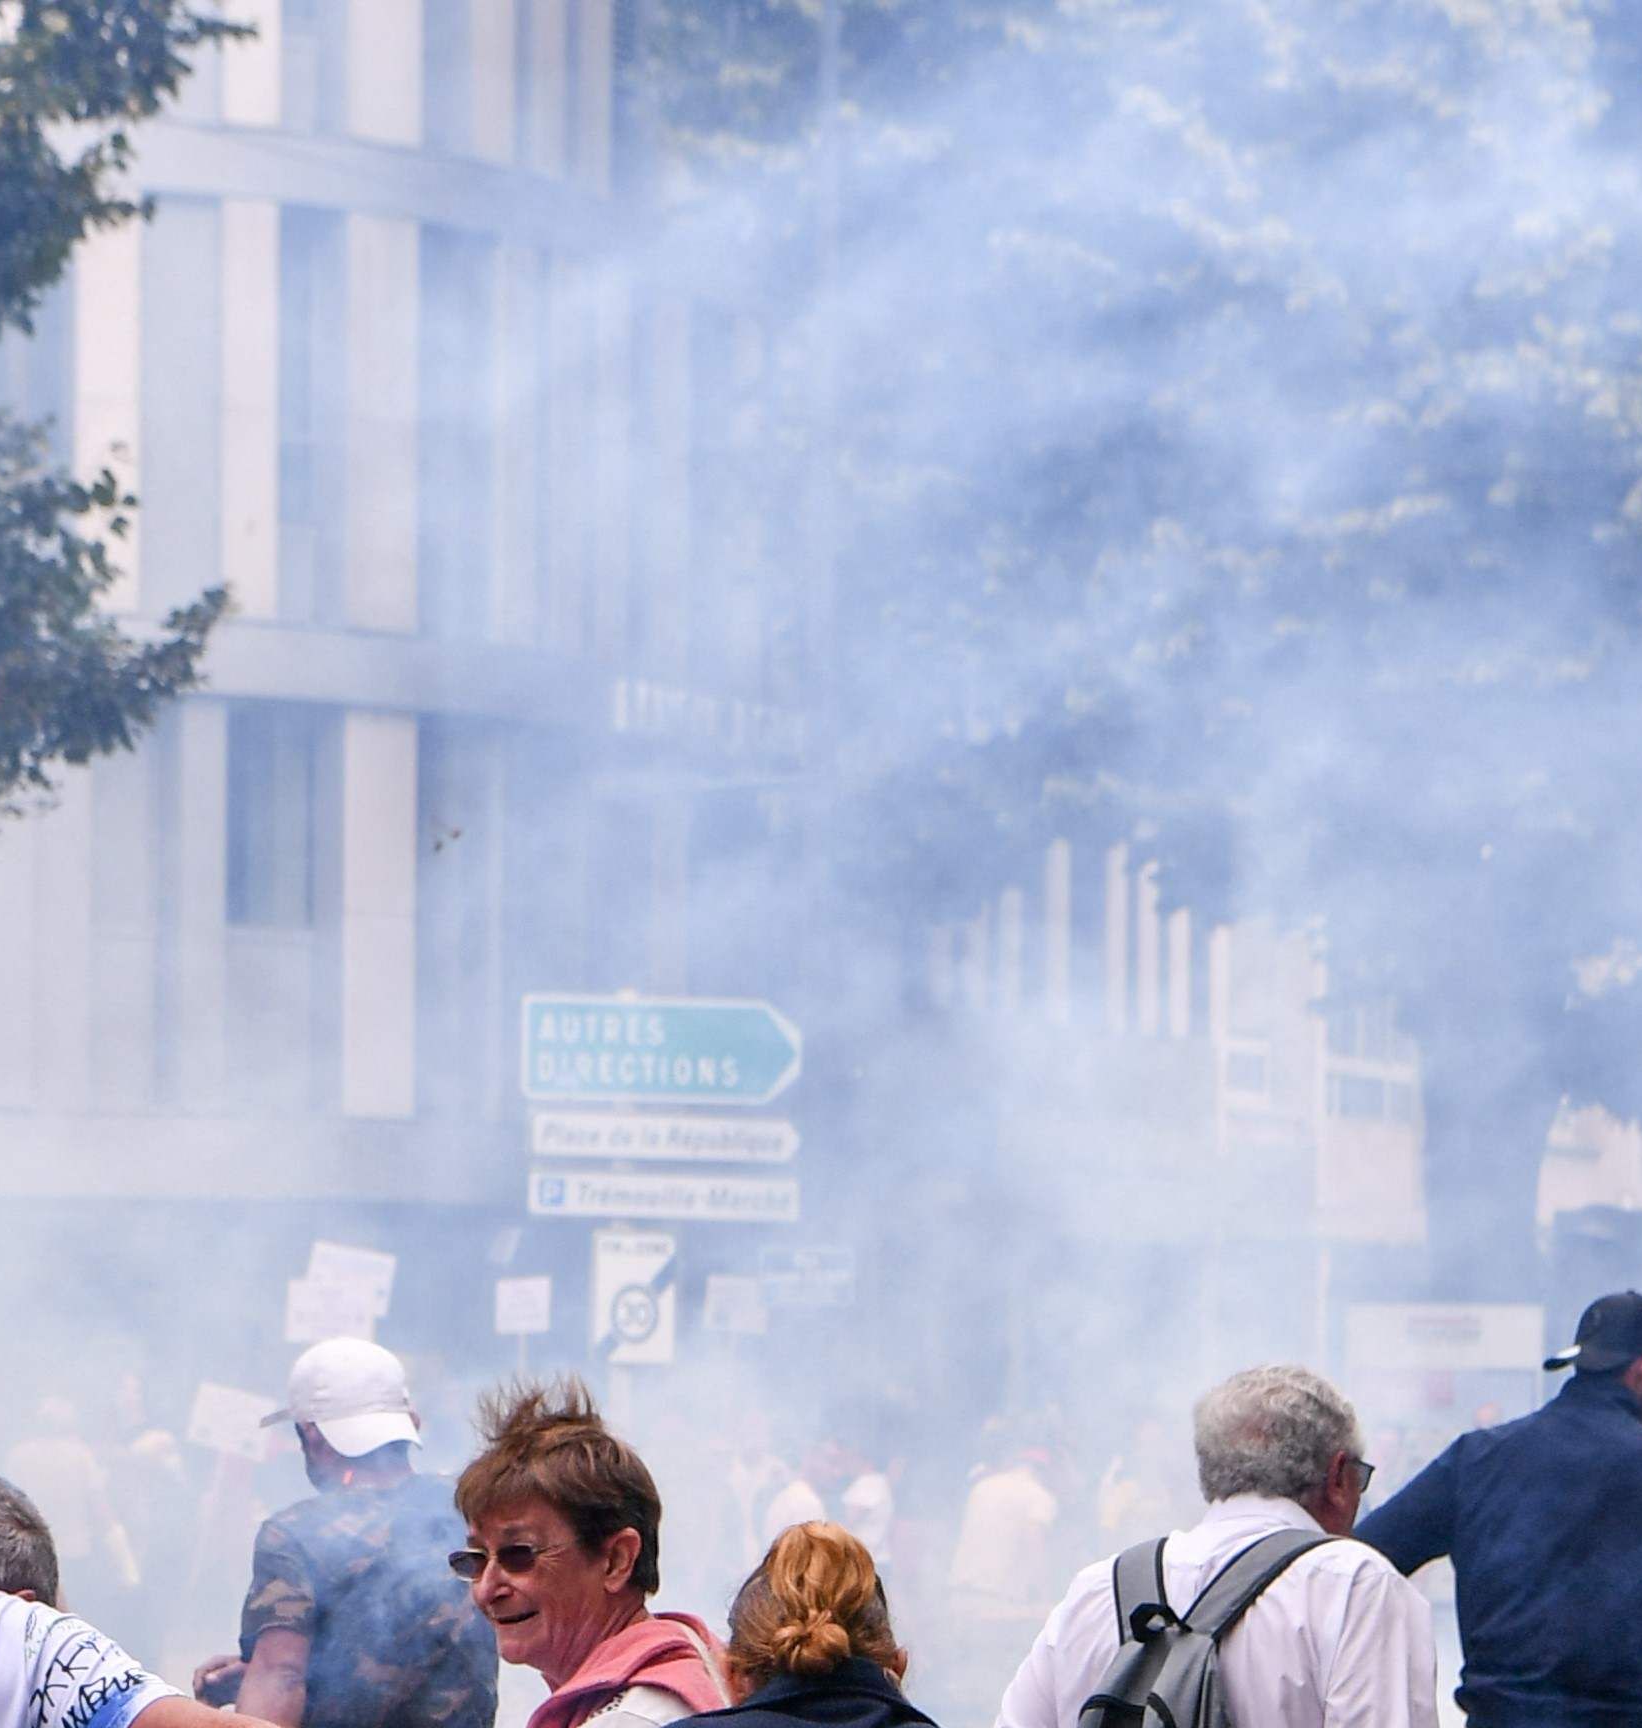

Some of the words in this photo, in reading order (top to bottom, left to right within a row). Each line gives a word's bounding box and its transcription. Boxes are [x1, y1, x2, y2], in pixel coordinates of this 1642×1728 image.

[536, 1010, 666, 1045] AUTRES
[536, 1049, 741, 1088] DIRECTIONS
[542, 1122, 601, 1147] Place
[608, 1124, 633, 1147] de
[666, 1125, 785, 1154] République
[621, 1300, 649, 1325] 30
